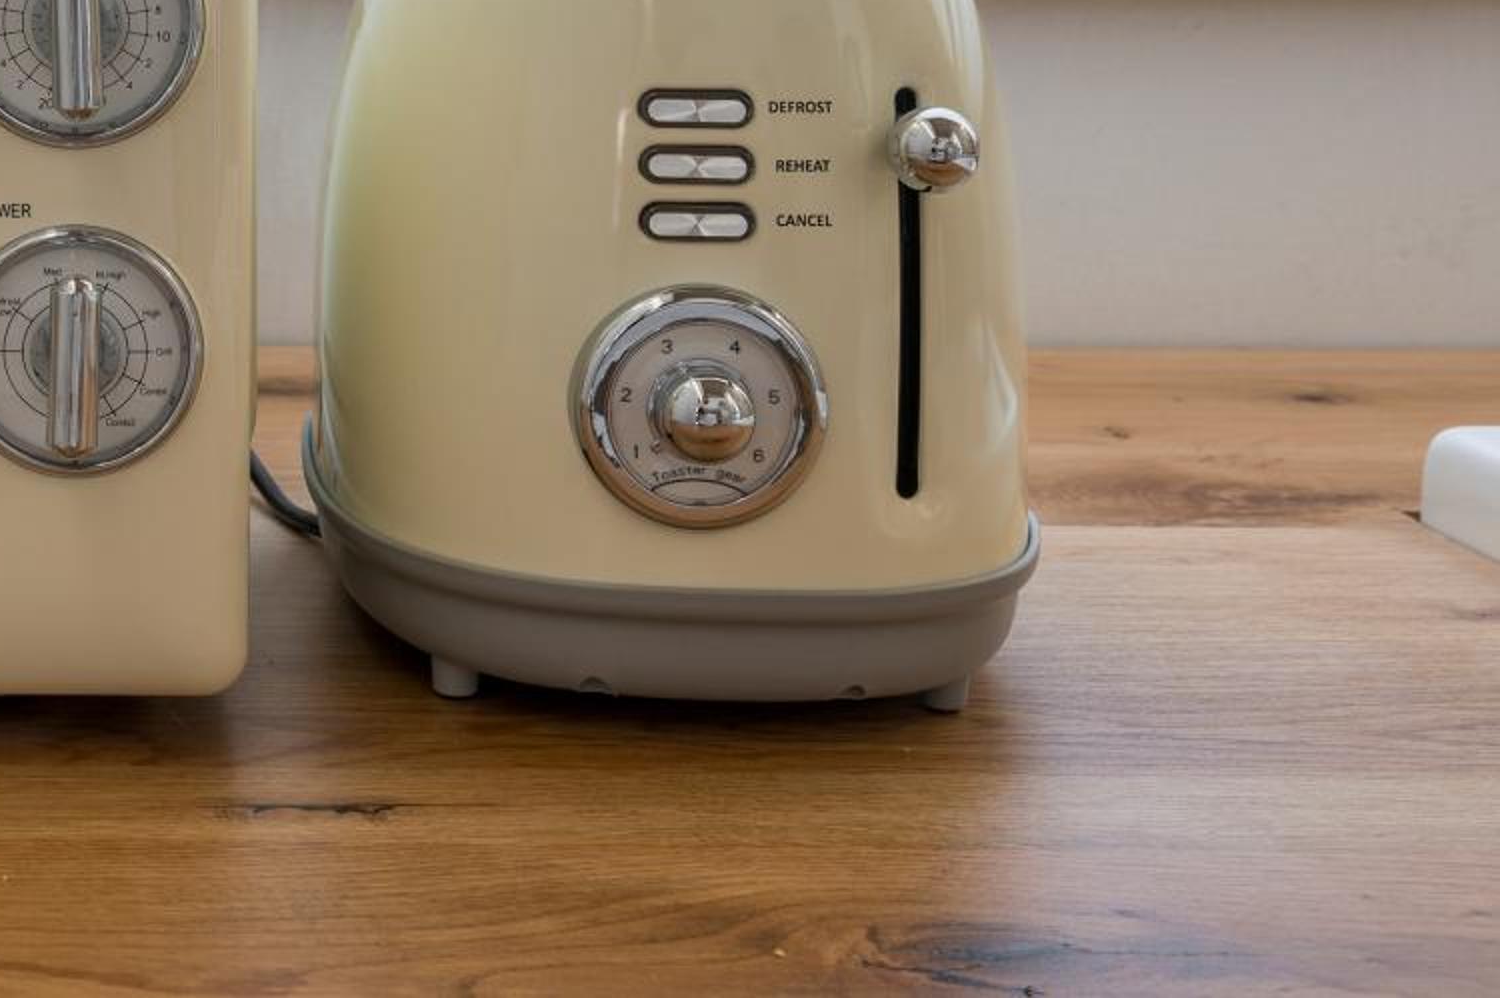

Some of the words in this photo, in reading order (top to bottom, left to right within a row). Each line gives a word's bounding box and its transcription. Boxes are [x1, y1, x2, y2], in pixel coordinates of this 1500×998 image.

[155, 31, 171, 44] 10
[768, 100, 833, 114] DEFROST
[775, 159, 831, 172] REHEAT
[775, 214, 833, 228] CANCEL
[661, 339, 674, 355] 3
[729, 339, 741, 354] 4
[619, 388, 633, 403] 2
[768, 388, 781, 405] 5
[633, 444, 639, 460] 1
[753, 448, 766, 463] 6
[651, 465, 708, 482] Toaster
[715, 468, 747, 483] gear
